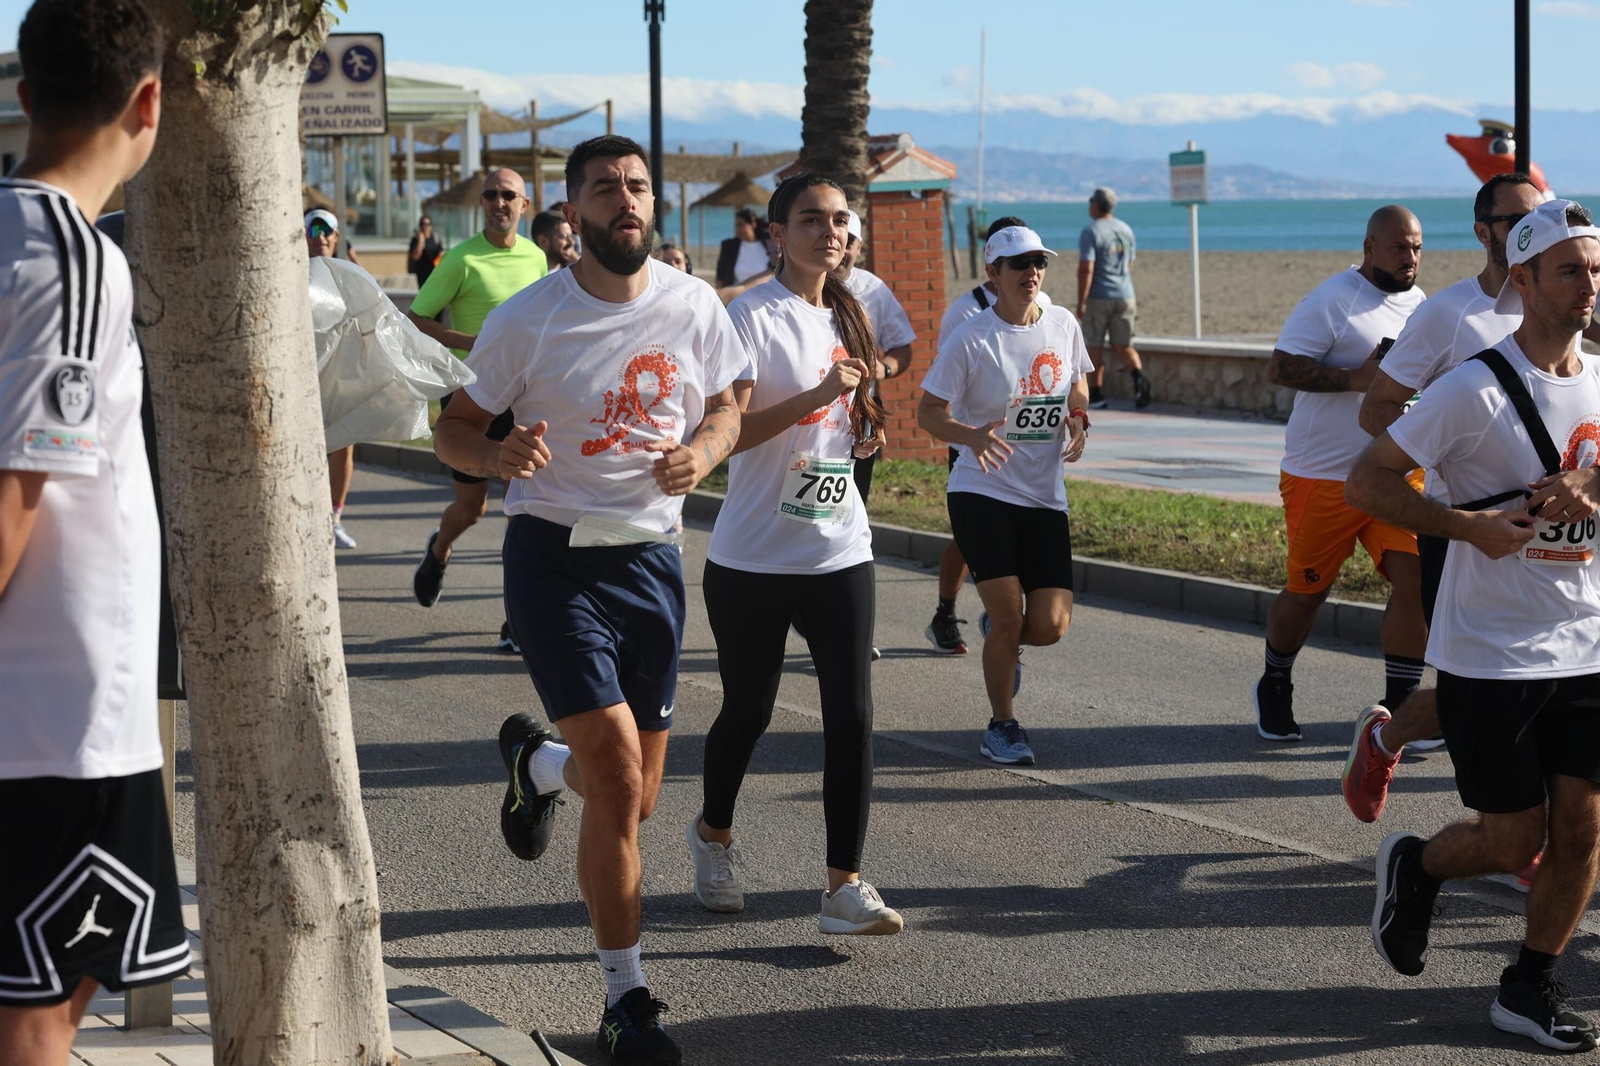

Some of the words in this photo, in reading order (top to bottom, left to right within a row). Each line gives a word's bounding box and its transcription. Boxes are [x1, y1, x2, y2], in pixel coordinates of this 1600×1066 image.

[324, 104, 372, 115] CARRIL
[304, 117, 382, 129] ENALIZADO
[1520, 228, 1534, 245] CSIF
[67, 393, 82, 406] 15
[1015, 406, 1062, 429] 636
[794, 472, 848, 504] 769
[782, 504, 797, 514] 024
[1539, 516, 1596, 544] 306
[1527, 550, 1545, 558] 024
